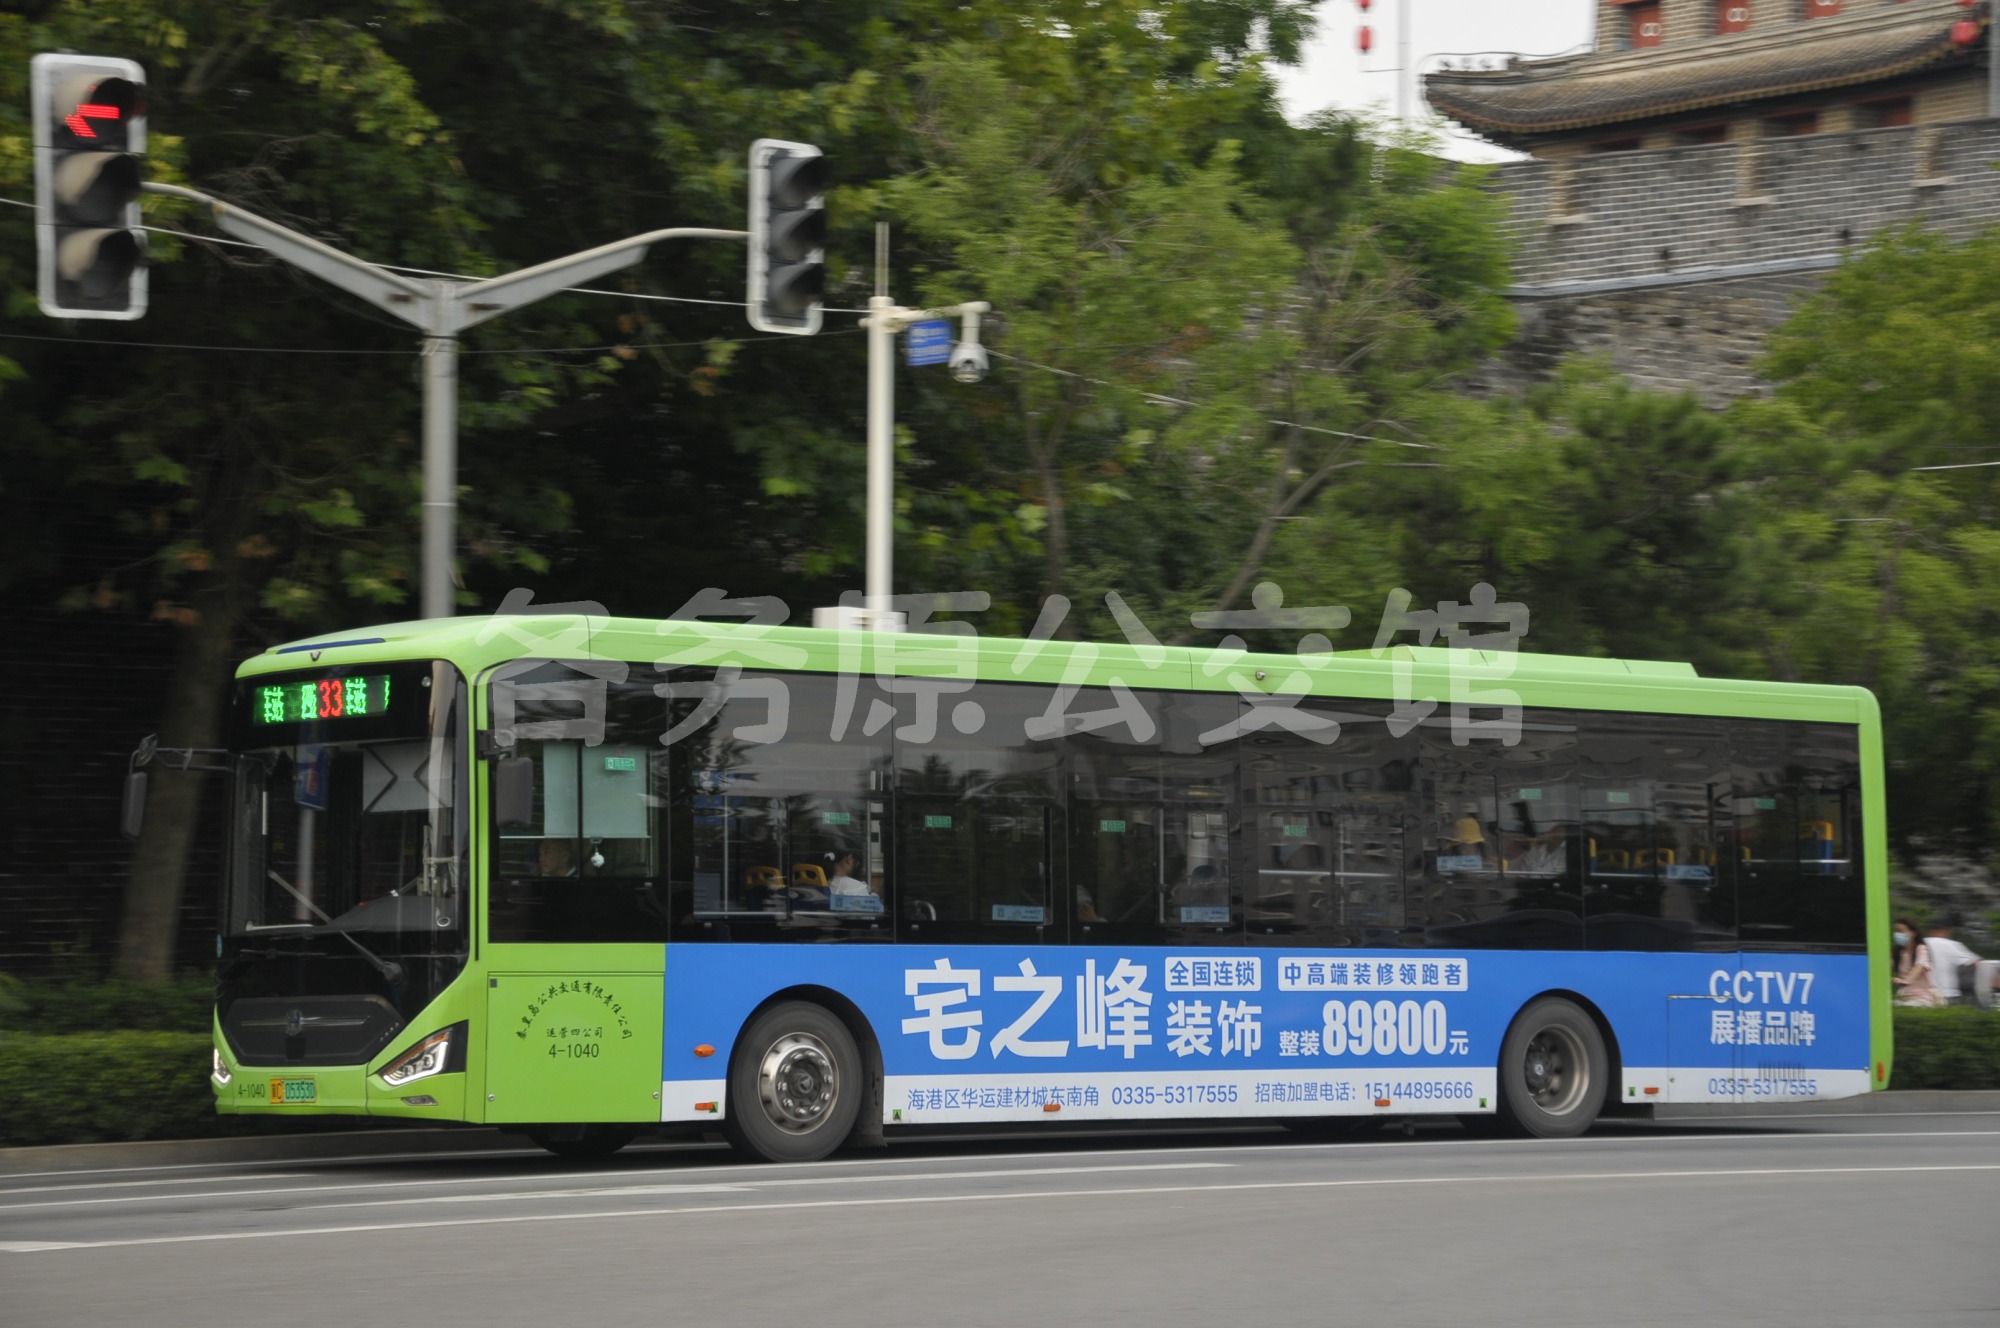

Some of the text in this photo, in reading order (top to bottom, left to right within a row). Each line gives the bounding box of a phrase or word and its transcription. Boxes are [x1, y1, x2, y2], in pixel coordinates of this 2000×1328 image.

[319, 680, 343, 718] 33
[1169, 960, 1256, 988] 全国连锁
[1284, 962, 1462, 987] 中高端装修领跑者
[1709, 969, 1815, 1005] CCTV7
[901, 958, 1153, 1061] 宅之峰
[1166, 1000, 1263, 1058] 装饰
[1710, 1010, 1816, 1047] 展播品牌
[548, 1043, 600, 1058] 4-1040
[237, 1083, 266, 1098] 4-1040
[907, 1085, 1099, 1111] 海港区华运建材城东南角
[1111, 1084, 1239, 1106] 0335-5317555
[1708, 1077, 1818, 1096] 0335-5317555
